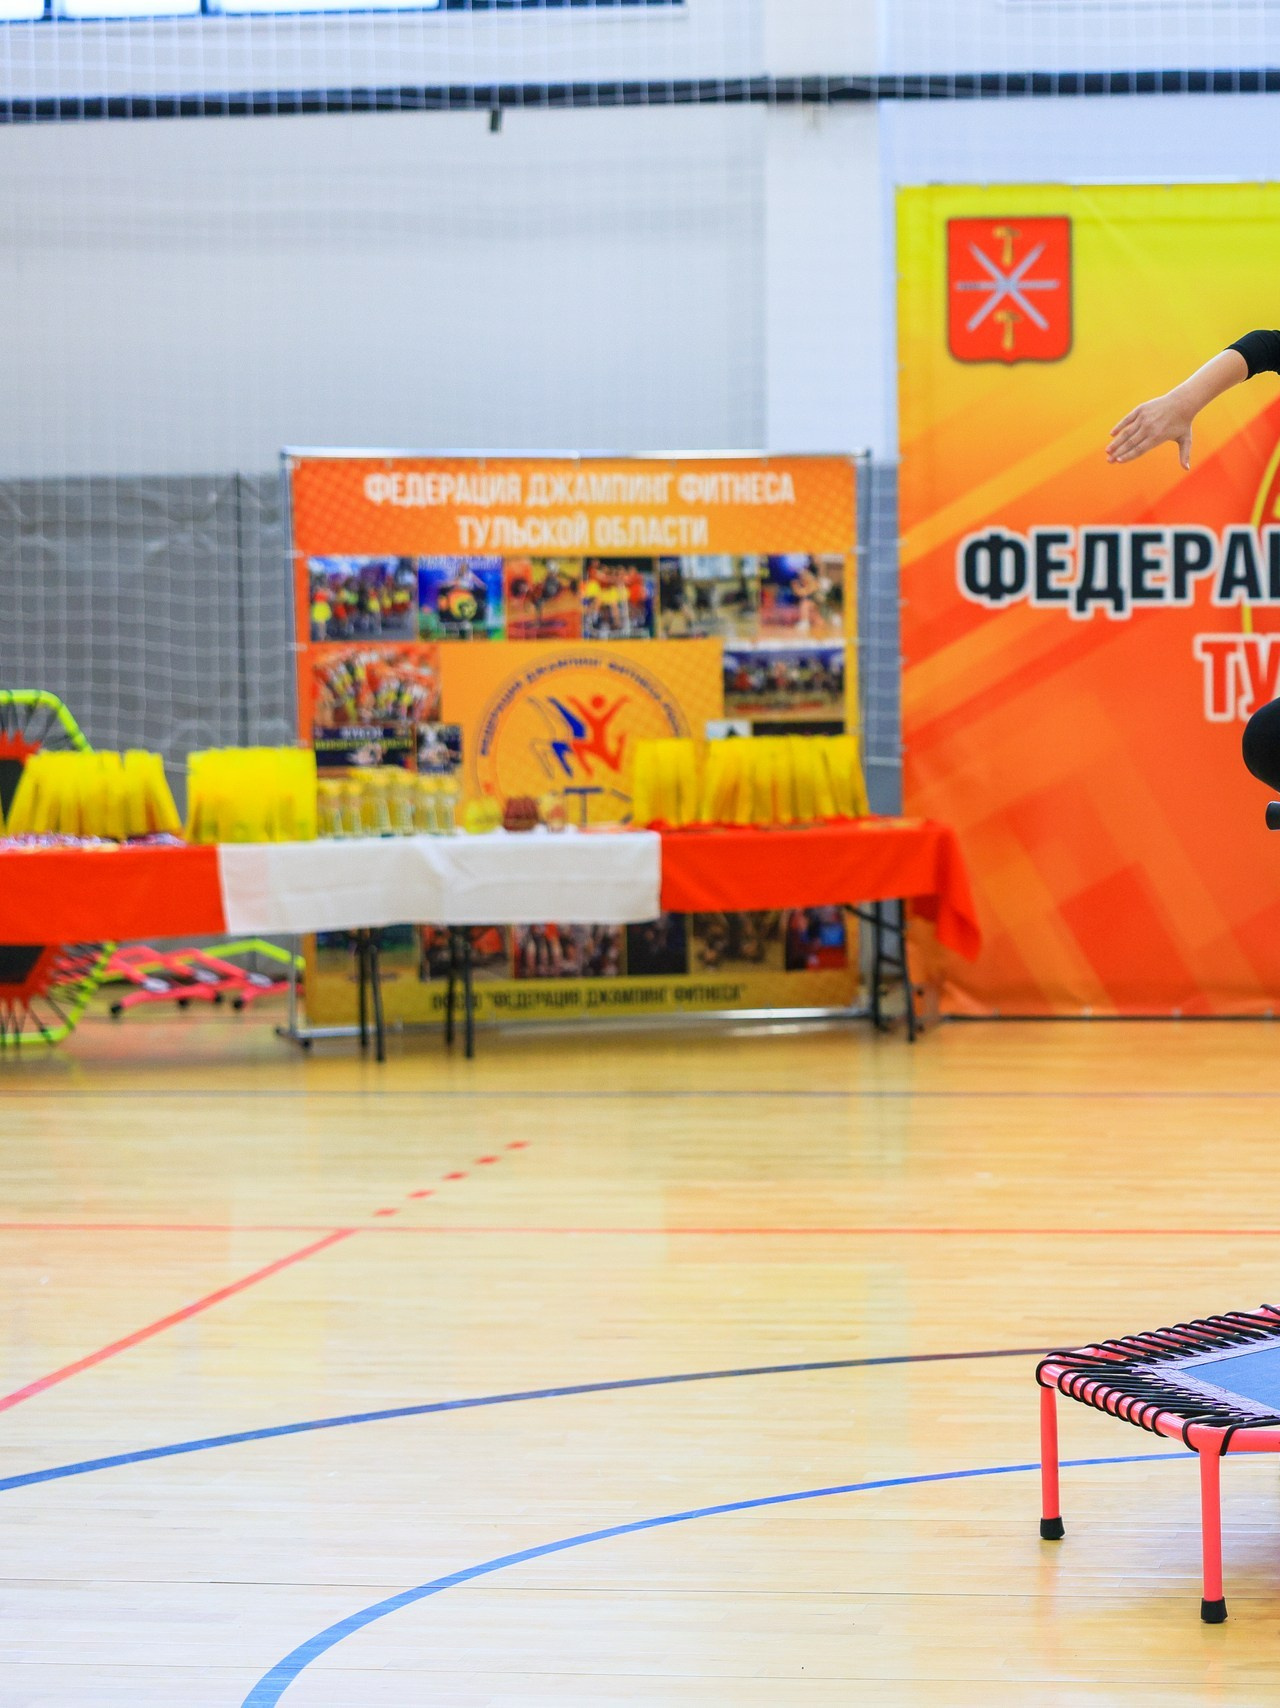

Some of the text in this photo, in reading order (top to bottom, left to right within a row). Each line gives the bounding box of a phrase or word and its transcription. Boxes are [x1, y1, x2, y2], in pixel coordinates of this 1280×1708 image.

[365, 471, 796, 507] ФЕДЕРАЦИЯ ДЖАМПИНГ ФИТНЕСА
[457, 511, 709, 549] ТУЛЬСКОЙ ОБЛАСТИ
